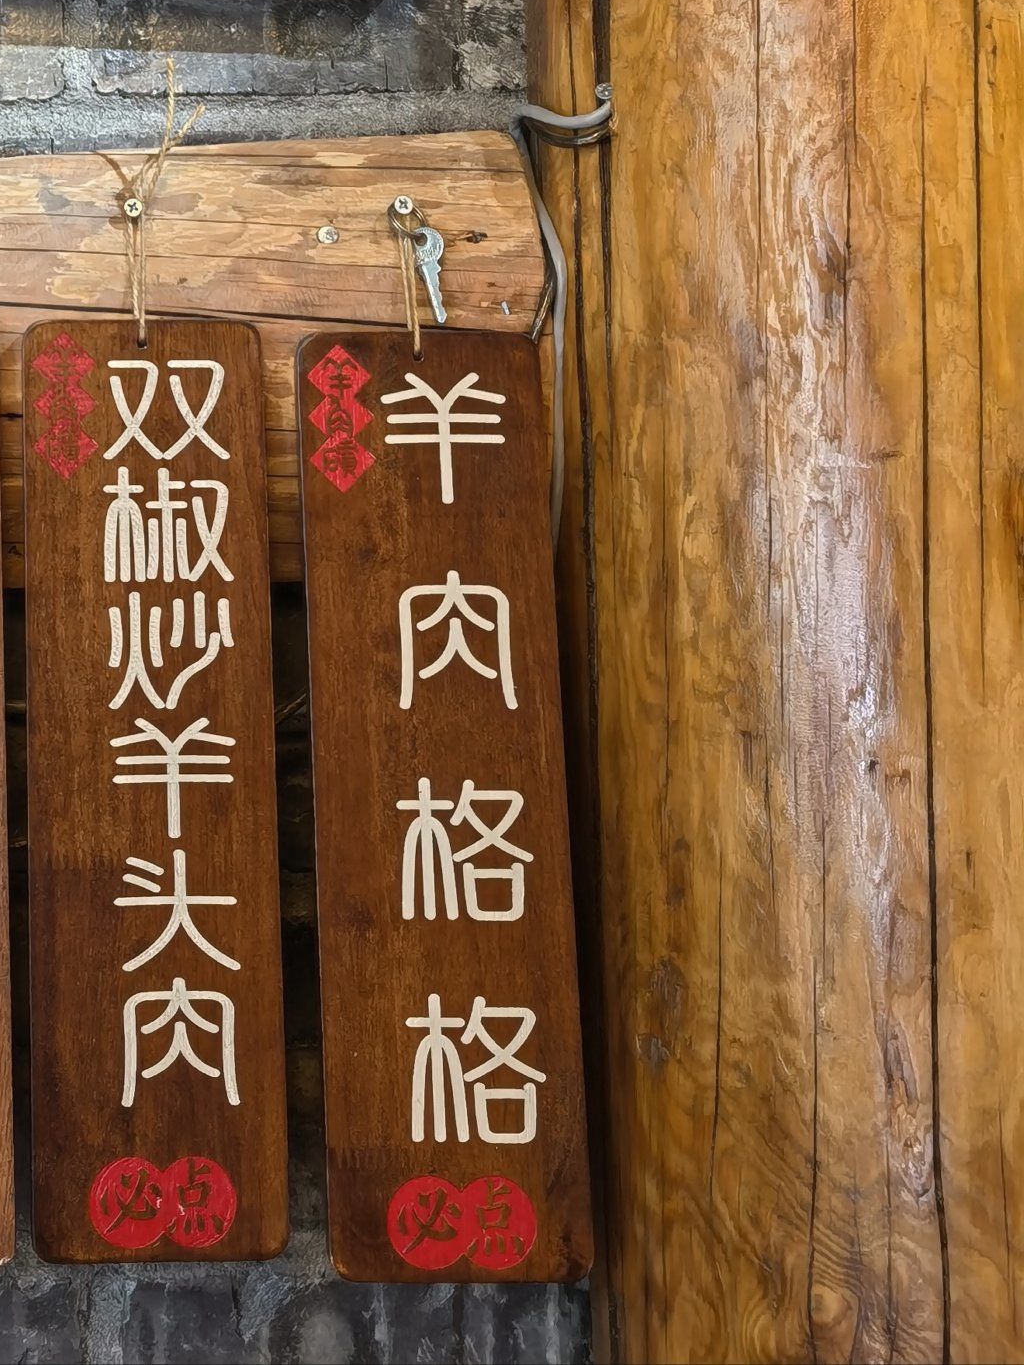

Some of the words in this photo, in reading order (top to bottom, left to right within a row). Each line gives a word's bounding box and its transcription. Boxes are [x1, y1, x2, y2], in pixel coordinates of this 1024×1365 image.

[103, 359, 242, 1107] 双椒炒羊头肉
[380, 372, 546, 1144] 羊肉格格
[100, 1157, 226, 1236] 必点
[396, 1185, 526, 1258] 必点
